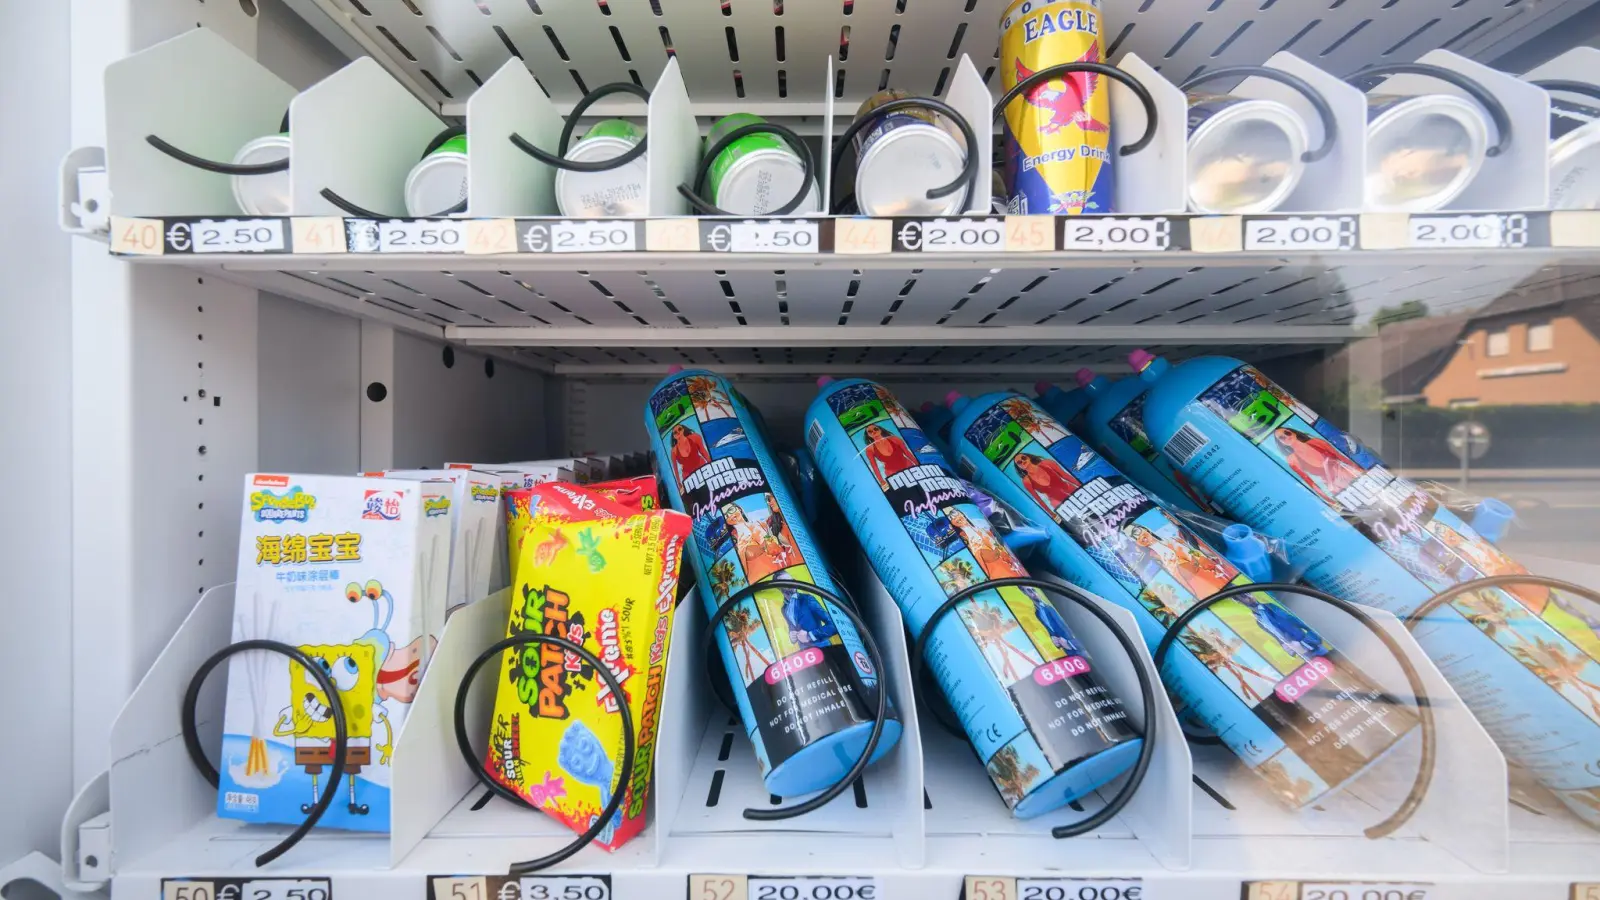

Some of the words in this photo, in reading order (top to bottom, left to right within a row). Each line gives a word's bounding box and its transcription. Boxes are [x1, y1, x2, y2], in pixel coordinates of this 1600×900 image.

[1025, 10, 1098, 43] EAGLE
[1024, 148, 1075, 171] Energy
[1080, 145, 1111, 164] Drink
[122, 225, 157, 248] 40
[166, 222, 191, 250] €
[202, 227, 273, 245] 2.50
[305, 224, 335, 246] 41
[389, 228, 459, 246] 2.50
[474, 225, 508, 248] 42
[523, 225, 548, 252] €
[557, 229, 628, 247] 2.50
[707, 225, 731, 252] €
[844, 224, 878, 246] 44
[898, 221, 922, 250] €
[928, 228, 1001, 245] 2.00
[1010, 223, 1045, 244] 45
[1074, 226, 1149, 245] 2,00
[1256, 227, 1332, 246] 2,00
[692, 479, 764, 521] Infusions
[256, 532, 362, 564] 海绵宝宝
[646, 553, 653, 563] WT
[647, 542, 656, 552] 3.5
[644, 564, 652, 575] NET
[621, 598, 636, 622] SOUR
[518, 590, 545, 706] SOUR
[649, 615, 669, 664] Kids
[539, 589, 569, 717] PATCH
[771, 652, 816, 679] 640G
[1041, 659, 1084, 681] 640G
[777, 696, 787, 706] DO
[790, 687, 804, 700] NOT
[807, 676, 834, 690] REFILL
[1283, 661, 1329, 697] 640G
[638, 665, 663, 747] PATCH
[769, 714, 782, 727] NOT
[784, 706, 799, 718] FOR
[800, 690, 836, 708] MEDICAL
[839, 685, 852, 693] USE
[1055, 699, 1067, 708] DO
[1070, 692, 1085, 701] NOT
[1087, 686, 1107, 696] REFILL
[785, 723, 795, 733] DO
[797, 714, 813, 727] NOT
[815, 700, 845, 717] INHALE
[1048, 718, 1065, 729] NOT
[1069, 710, 1084, 721] FOR
[1085, 700, 1115, 713] MEDICAL
[1071, 726, 1084, 736] DO
[1087, 718, 1102, 729] NOT
[1104, 711, 1127, 722] INHALE
[1307, 713, 1322, 724] DO
[1323, 701, 1337, 714] NOT
[1307, 734, 1321, 746] NOT
[1324, 722, 1338, 734] FOR
[1333, 737, 1348, 750] DO
[1348, 726, 1365, 738] NOT
[503, 739, 516, 779] SOUR
[628, 743, 652, 819] SOUR
[452, 883, 481, 900] 51
[703, 880, 735, 900] 52
[758, 885, 876, 900] 20.00€
[974, 881, 1006, 900] 53
